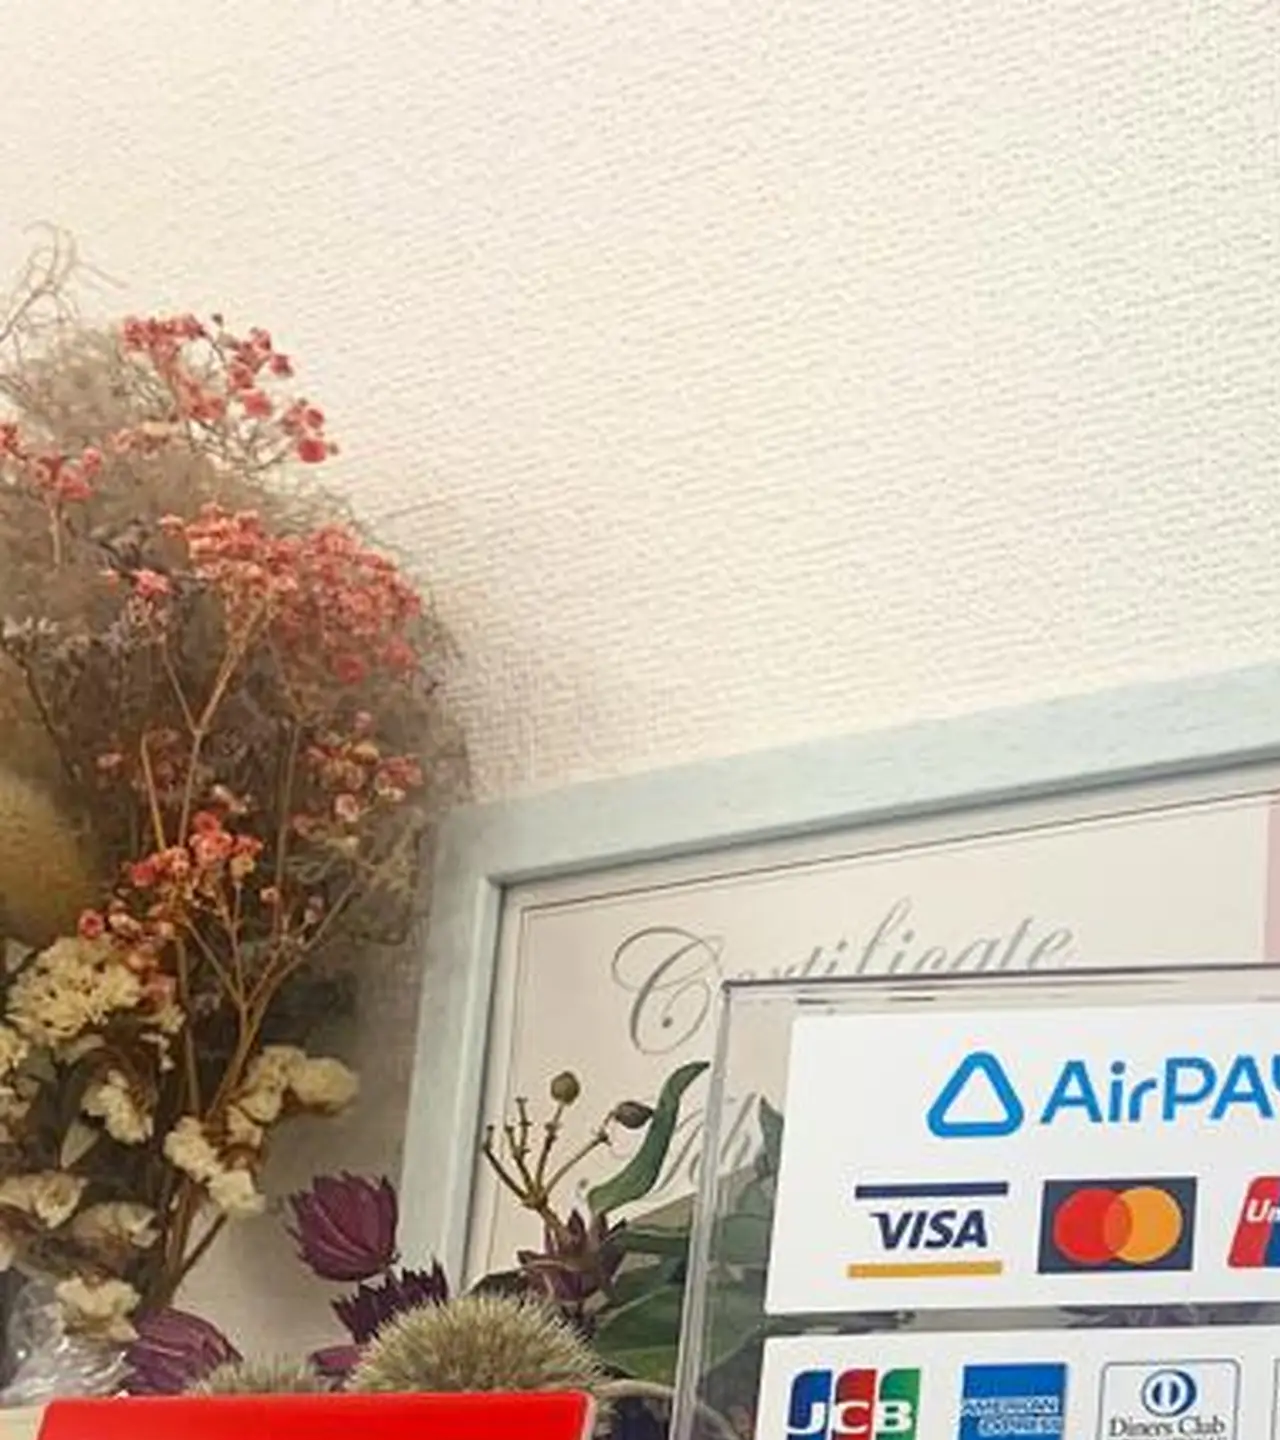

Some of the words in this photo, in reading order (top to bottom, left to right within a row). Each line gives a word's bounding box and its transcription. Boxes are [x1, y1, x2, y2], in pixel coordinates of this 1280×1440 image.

[869, 1209, 989, 1251] VISA
[785, 1400, 916, 1435] JCB
[961, 1396, 1060, 1417] AMERICAN
[1109, 1416, 1174, 1437] Diners
[1178, 1415, 1226, 1435] Club
